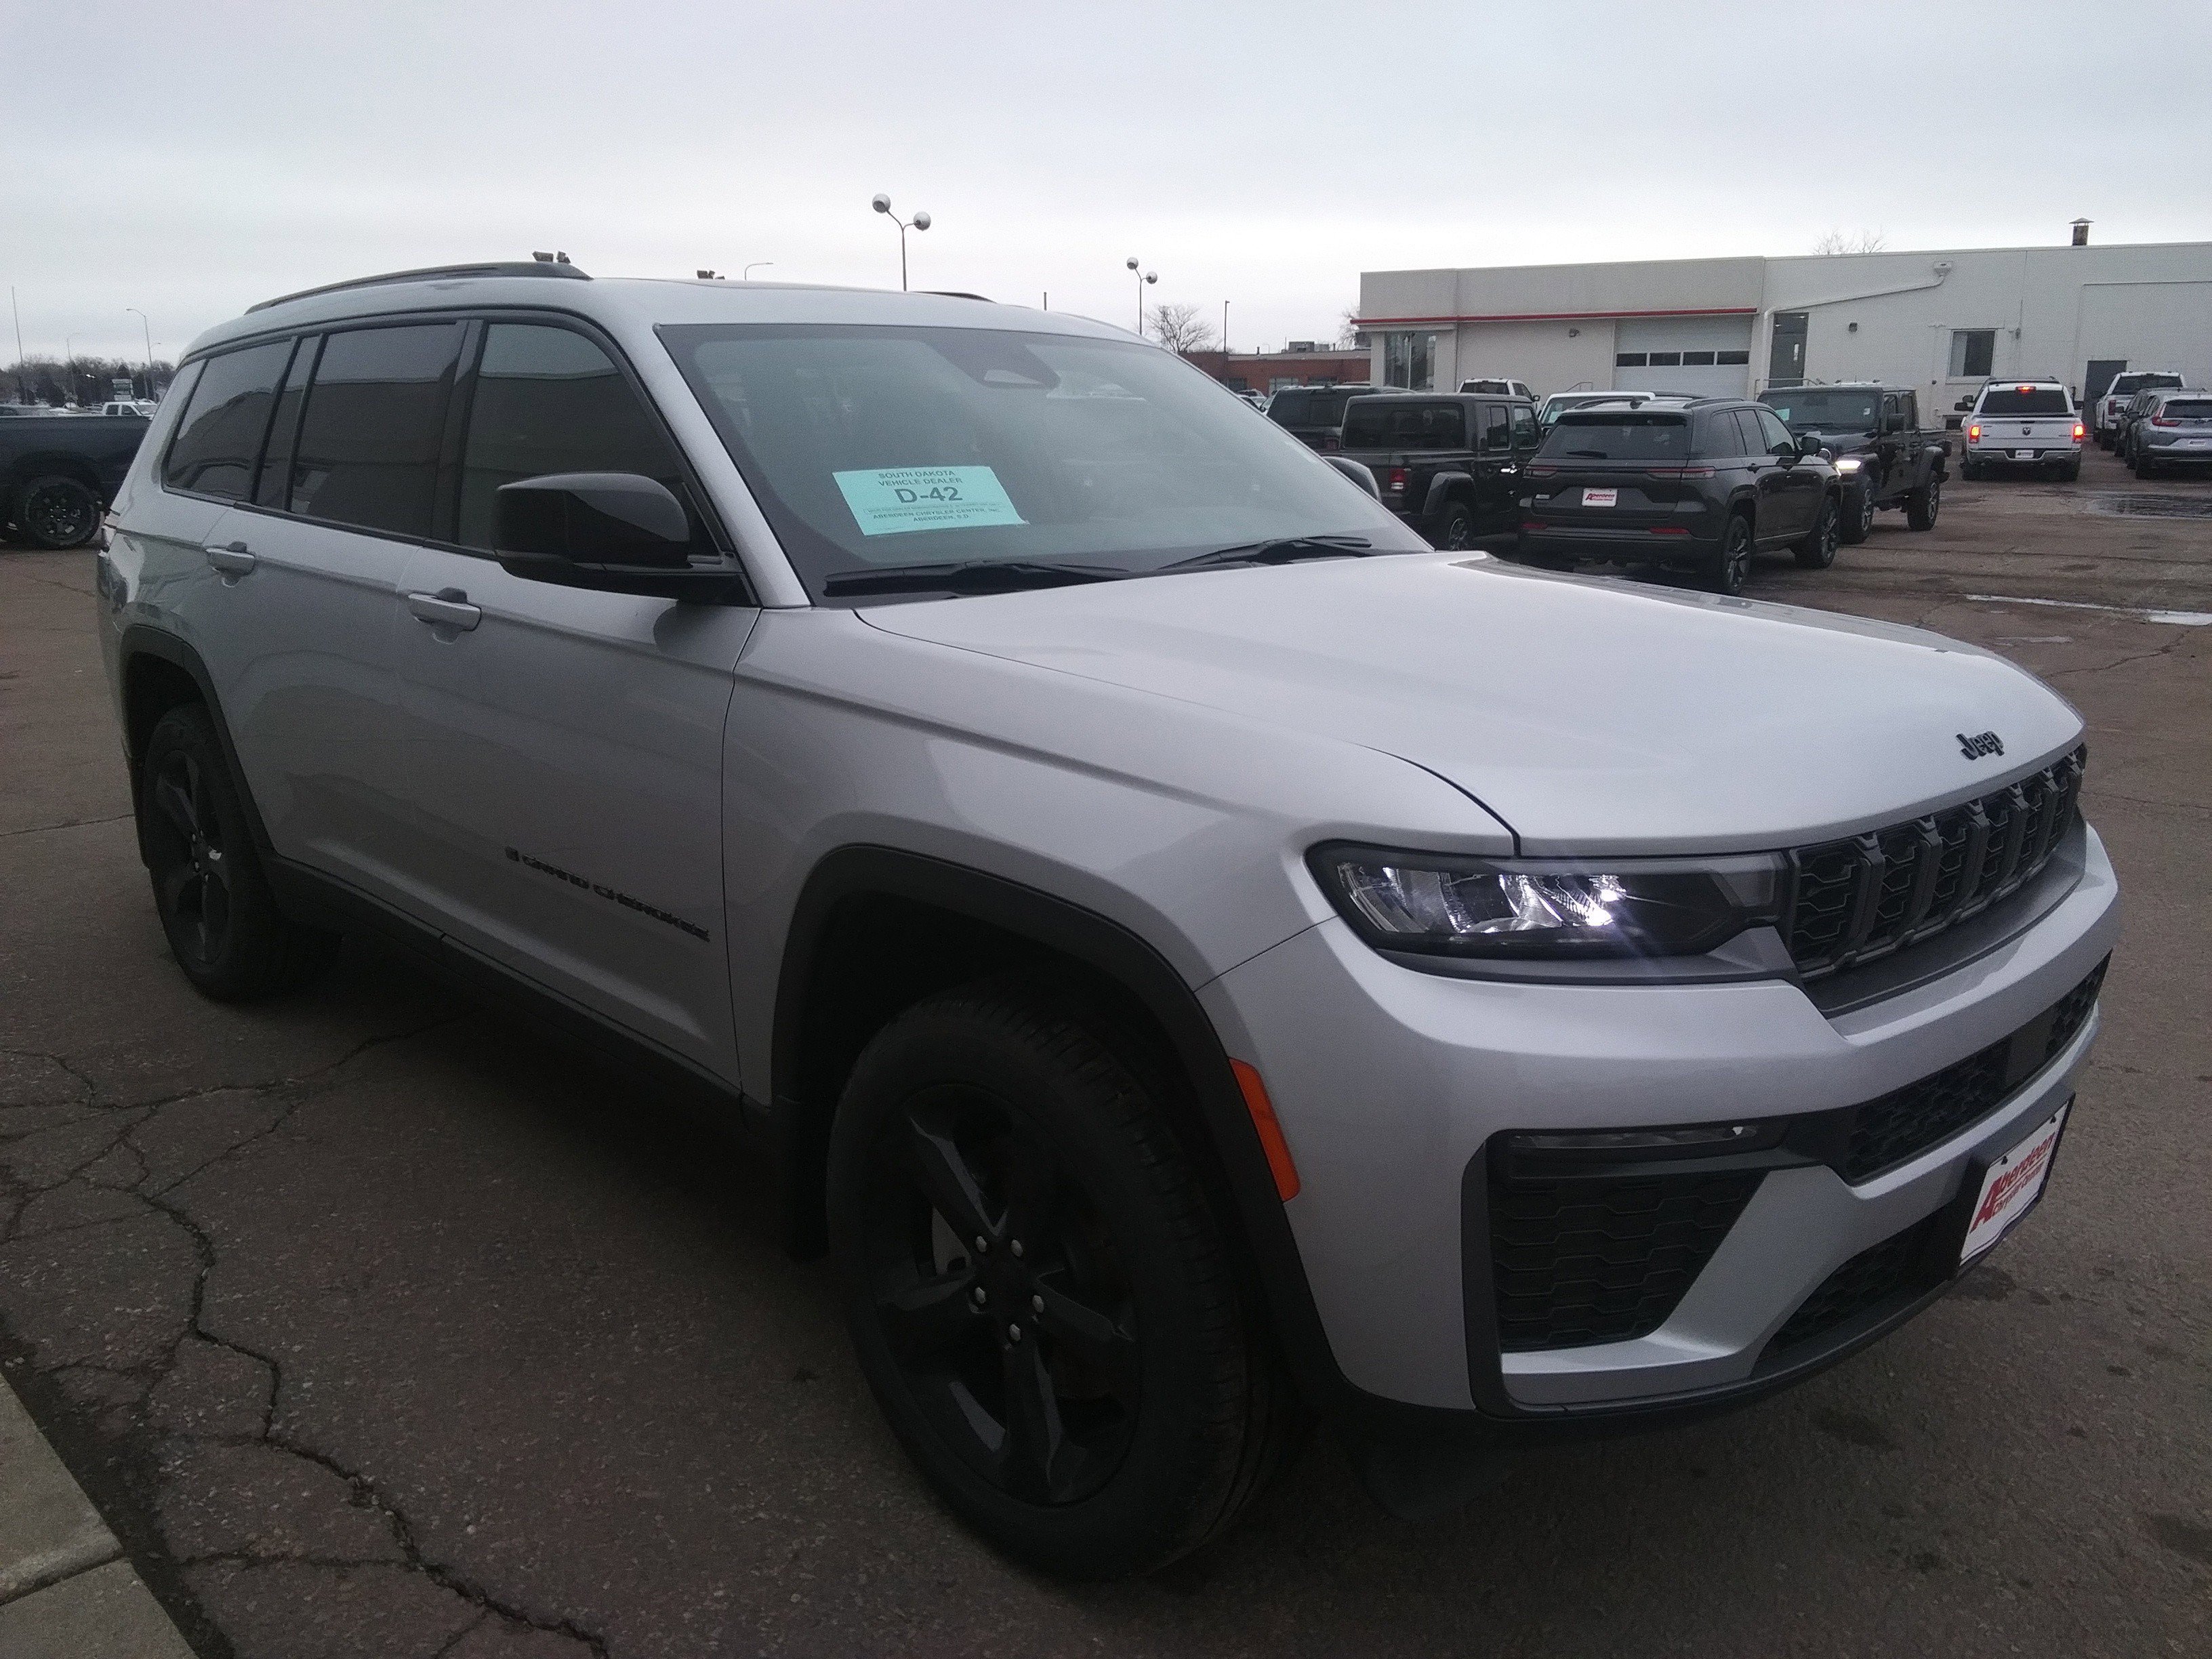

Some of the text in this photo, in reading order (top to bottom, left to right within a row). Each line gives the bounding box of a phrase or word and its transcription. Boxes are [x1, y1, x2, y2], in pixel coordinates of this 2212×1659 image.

[894, 487, 963, 503] D-42
[1956, 731, 2005, 760] Jeep
[1969, 1132, 2056, 1234] Aberdeen
